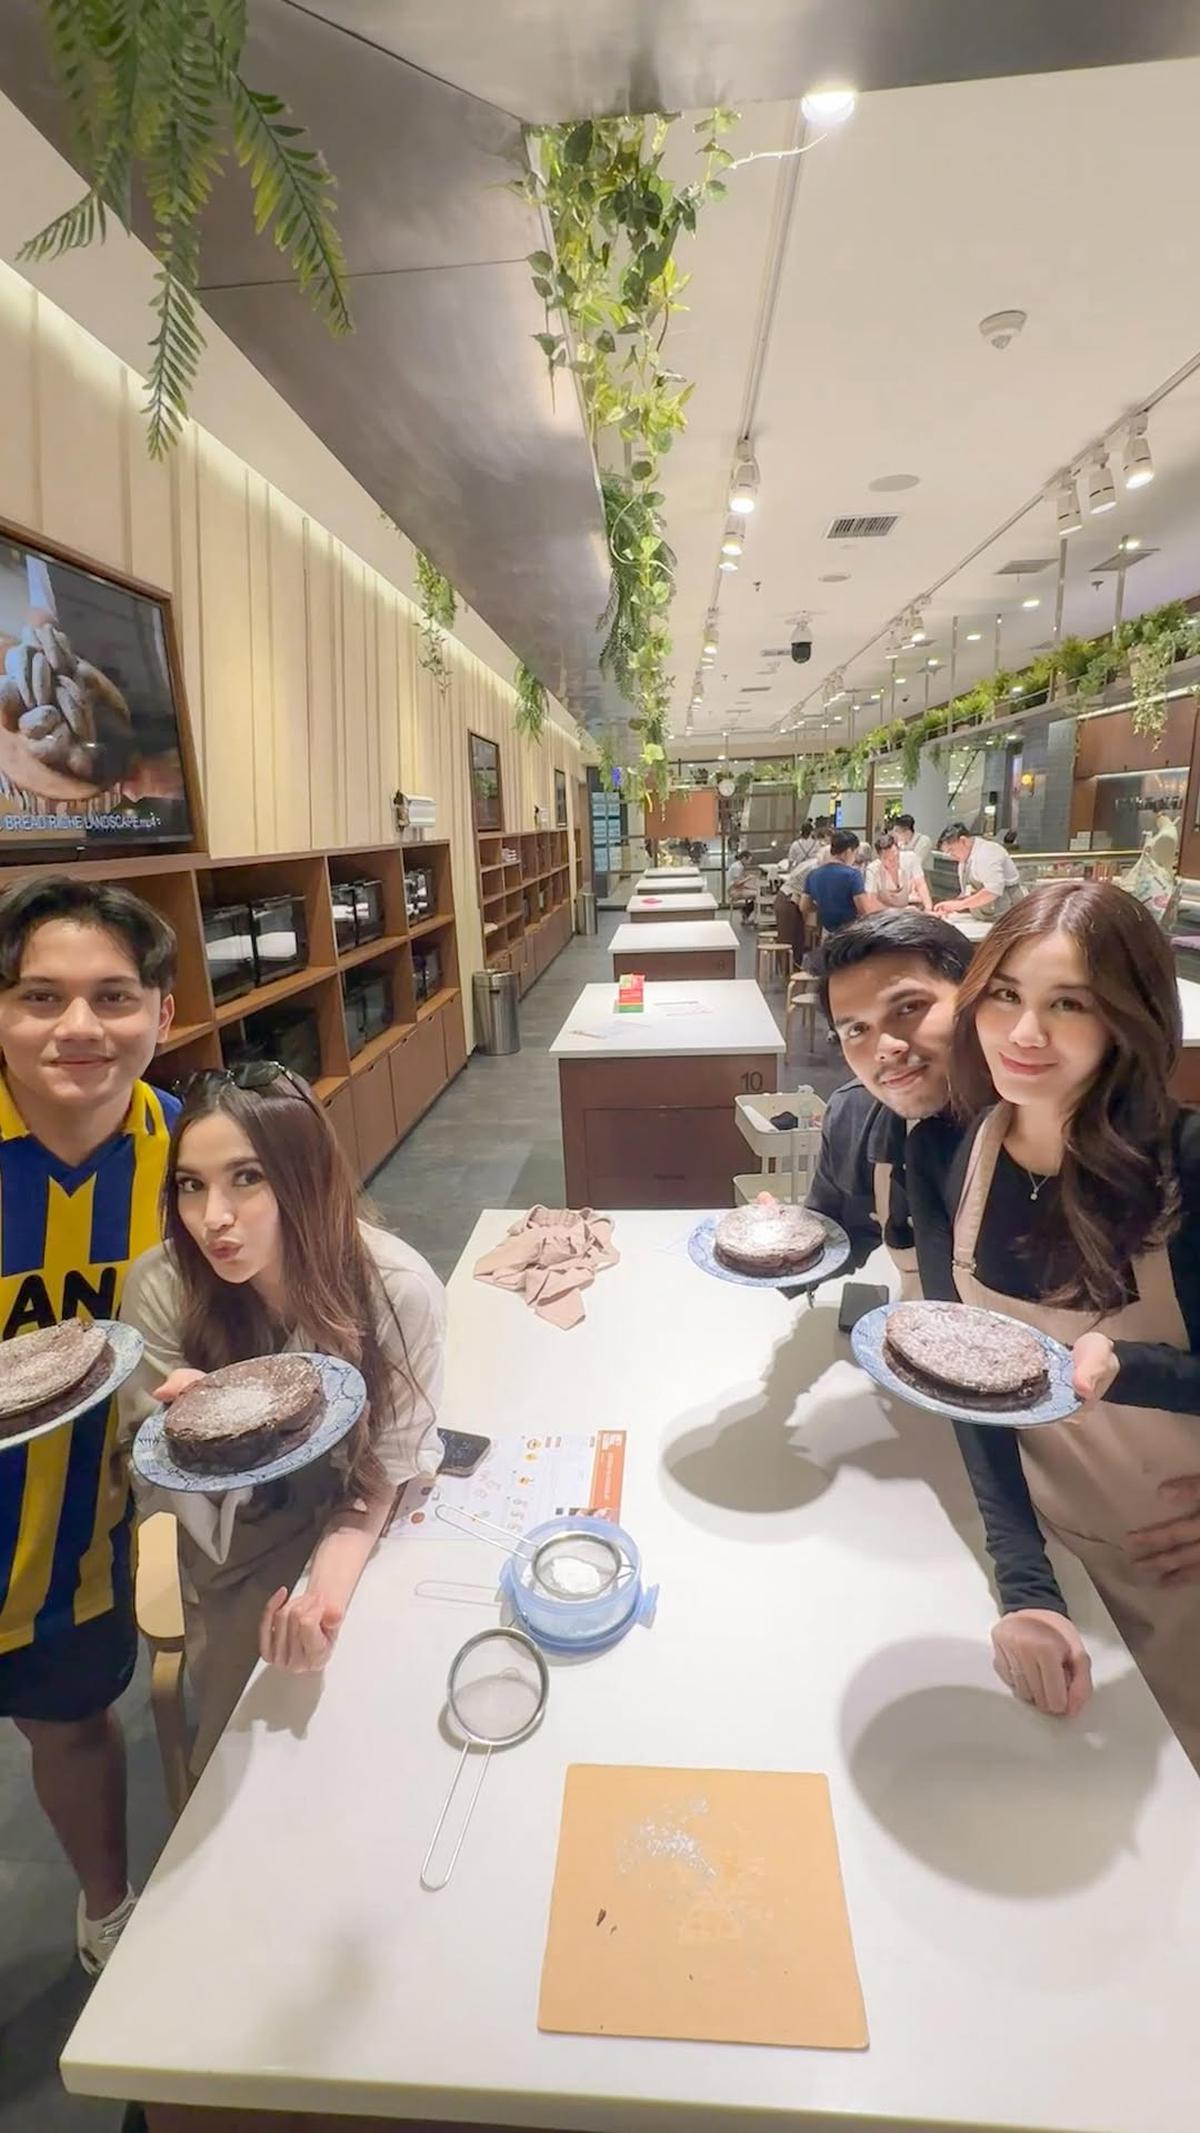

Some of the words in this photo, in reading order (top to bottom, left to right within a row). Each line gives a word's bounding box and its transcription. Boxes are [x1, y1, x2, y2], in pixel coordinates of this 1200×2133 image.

[6, 815, 47, 831] BREAD
[741, 1071, 763, 1091] 10
[2, 1267, 121, 1341] AN
